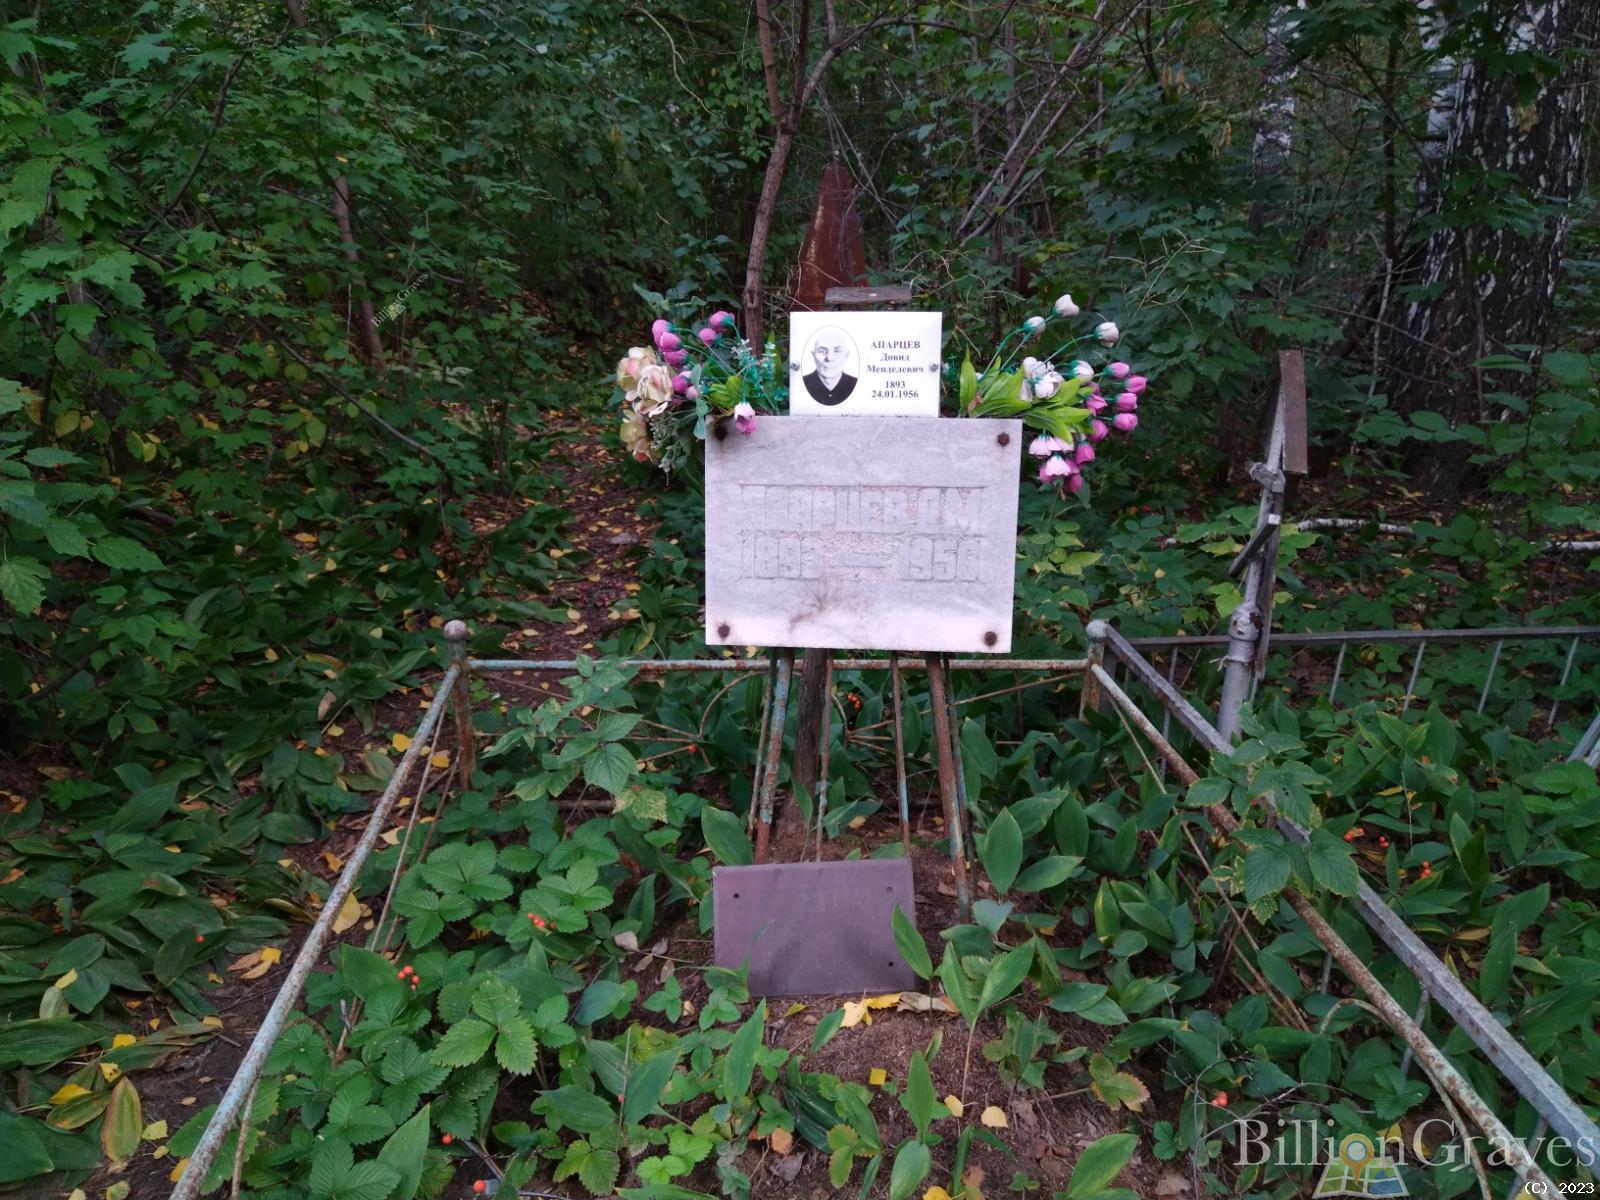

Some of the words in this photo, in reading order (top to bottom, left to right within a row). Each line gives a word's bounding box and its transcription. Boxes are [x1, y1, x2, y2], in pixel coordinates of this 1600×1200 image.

[870, 341, 921, 350] АПАРЦЕВ
[880, 353, 910, 362] Довид
[866, 364, 924, 374] Менделевич
[885, 380, 906, 389] 1893
[871, 390, 919, 399] 24.01.1956
